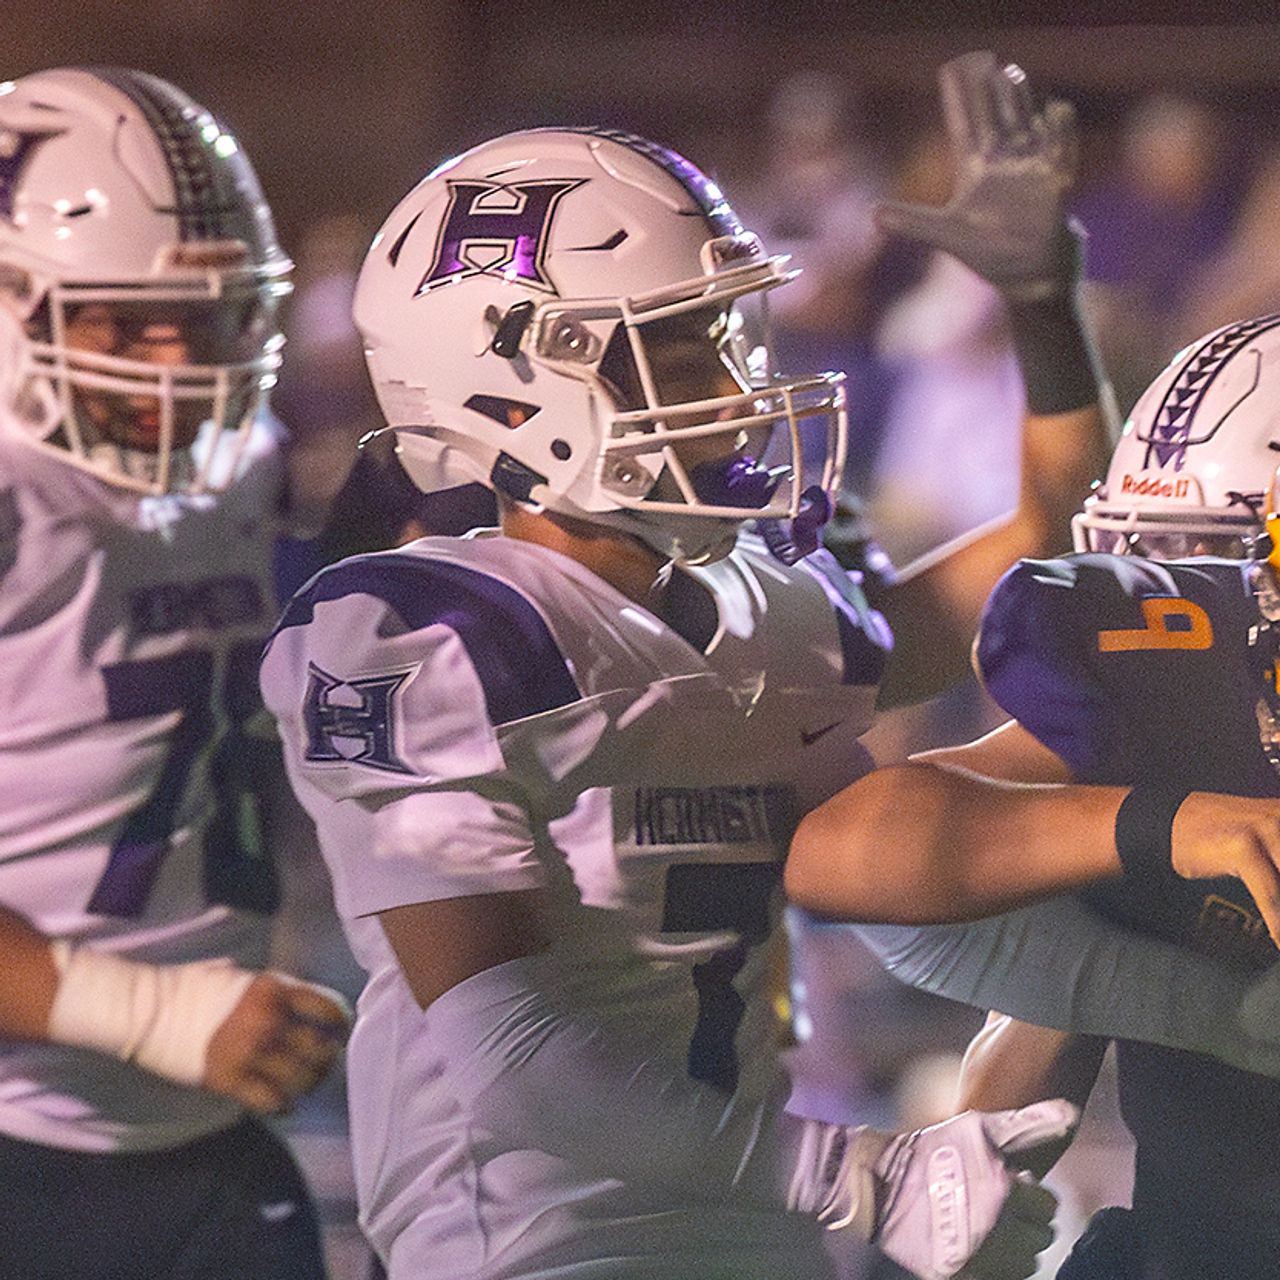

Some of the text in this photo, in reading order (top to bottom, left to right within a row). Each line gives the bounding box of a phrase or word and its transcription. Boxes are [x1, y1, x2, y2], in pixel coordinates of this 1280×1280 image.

[412, 178, 592, 298] H
[1120, 474, 1189, 497] Riddell
[302, 660, 424, 778] H
